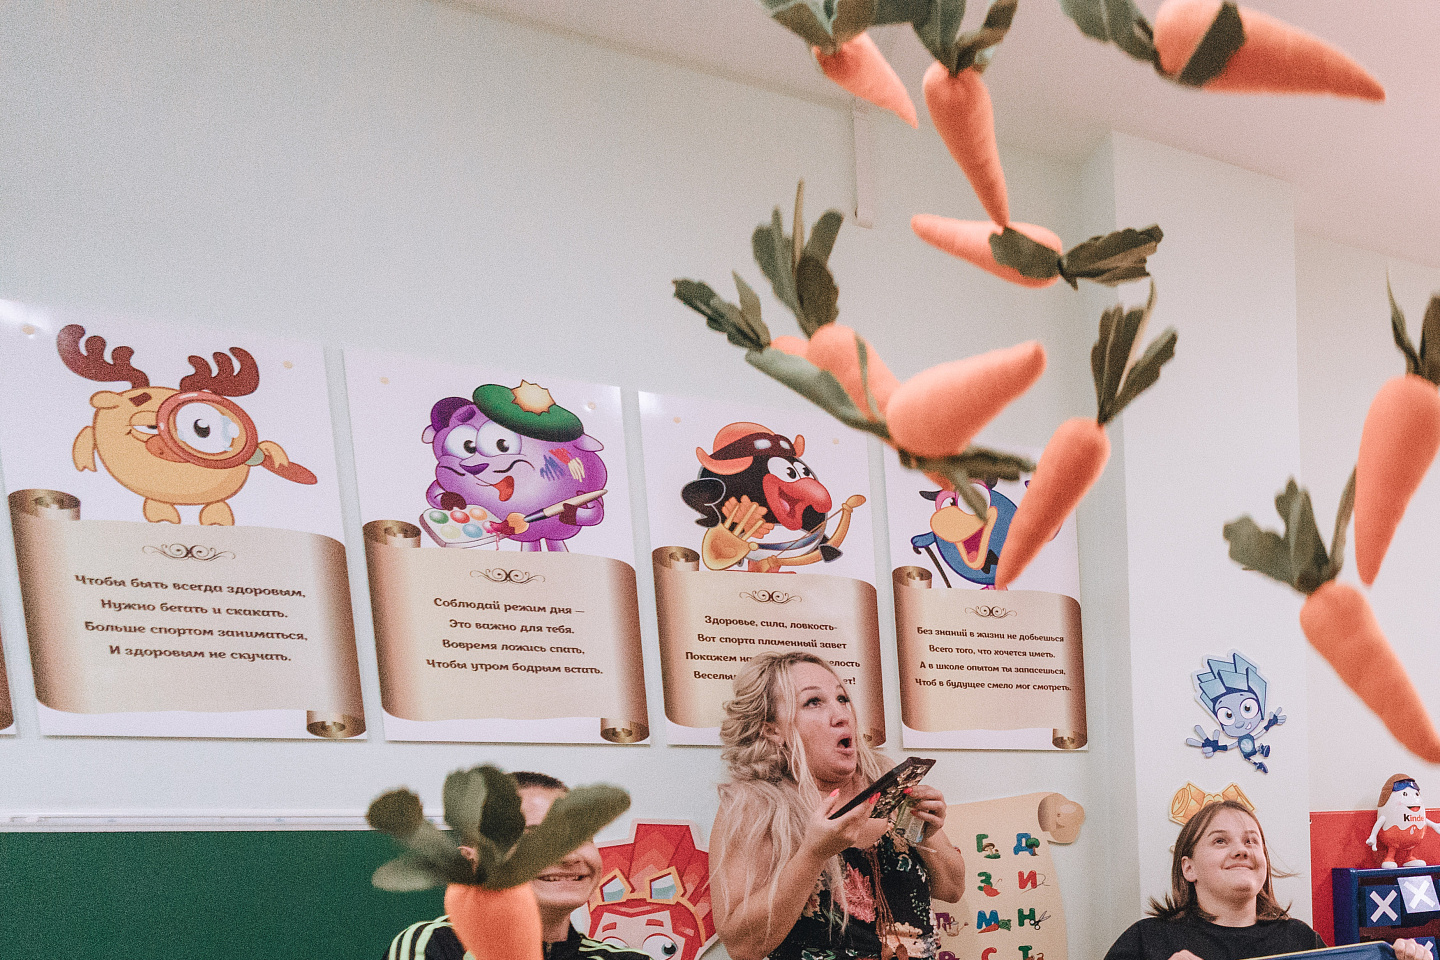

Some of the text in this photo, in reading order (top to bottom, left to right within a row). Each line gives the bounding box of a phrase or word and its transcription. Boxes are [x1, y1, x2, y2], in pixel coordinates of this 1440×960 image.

[74, 574, 306, 598] Чтобы быть всегда здоровым,
[100, 598, 288, 618] Нужно бегать и скакать.
[433, 597, 501, 611] Соблюдай
[503, 604, 547, 613] режим
[549, 606, 572, 615] дня
[449, 618, 575, 634] Это важно для тебя.
[704, 615, 758, 627] Здоровье,
[760, 620, 788, 629] сила,
[84, 621, 308, 641] Больше спортом заниматься,
[917, 627, 933, 635] Без
[935, 628, 968, 637] знаний
[1018, 633, 1064, 642] добьешься
[442, 639, 585, 655] Вовремя ложись спать,
[697, 633, 717, 643] Вот
[719, 636, 756, 646] спорта
[757, 638, 818, 648] пламенный
[108, 644, 292, 663] И здоровым не скучать.
[685, 651, 737, 662] Покажем
[928, 644, 954, 653] Всего
[993, 649, 1027, 657] хочется
[426, 659, 603, 674] Чтобы утром бодрым встать.
[919, 661, 926, 669] А
[935, 663, 965, 671] школе
[693, 670, 737, 680] Веселы
[915, 678, 937, 687] Чтоб
[945, 679, 986, 690] будущее
[1032, 684, 1072, 692] смотреть.
[1013, 833, 1034, 855] Д
[1018, 870, 1037, 889] И
[976, 910, 999, 929] М
[1017, 908, 1036, 927] Н
